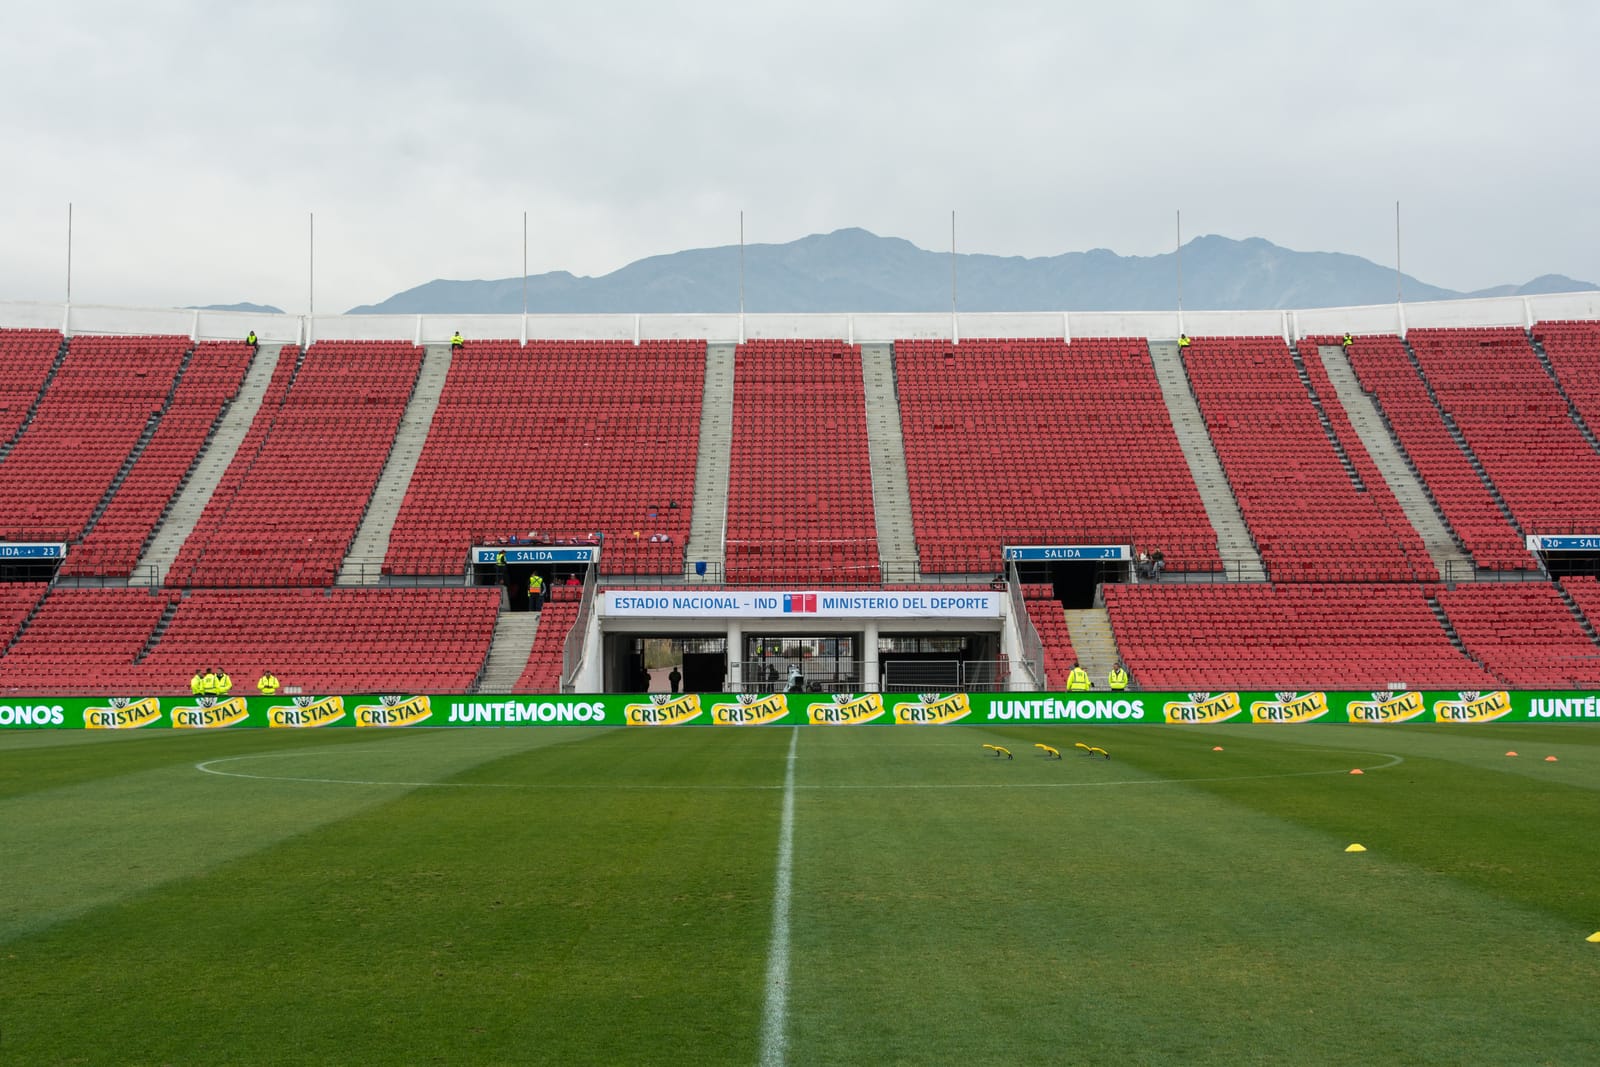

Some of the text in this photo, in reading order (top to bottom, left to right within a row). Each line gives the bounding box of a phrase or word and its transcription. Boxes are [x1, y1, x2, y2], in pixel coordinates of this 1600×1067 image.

[0, 547, 55, 556] IDA 23
[1012, 549, 1115, 558] 21 SALIDA 21
[1547, 539, 1559, 548] 20
[483, 551, 588, 561] 22 SALIDA 22
[615, 597, 669, 609] ESTADIO
[672, 597, 740, 609] NACIONAL
[754, 597, 778, 609] IND
[822, 597, 899, 609] MINISTERIO
[902, 597, 927, 609] DEL
[930, 597, 989, 609] DEPORTE
[0, 705, 64, 725] ONOS
[90, 703, 155, 726] CRISTAL
[177, 703, 242, 726] CRISTAL
[274, 701, 338, 724] CRISTAL
[361, 701, 425, 724] CRISTAL
[448, 700, 605, 722] JUNTÉMONOS
[631, 700, 695, 722] CRISTAL
[718, 699, 782, 722] CRISTAL
[813, 699, 878, 721] CRISTAL
[900, 699, 964, 721] CRISTAL
[987, 698, 1144, 719] JUNTÉMONOS
[1170, 698, 1234, 720] CRISTAL
[1257, 698, 1321, 720] CRISTAL
[1353, 697, 1418, 720] CRISTAL
[1440, 696, 1505, 720] CRISTAL
[1528, 695, 1600, 718] JUNTÉ
